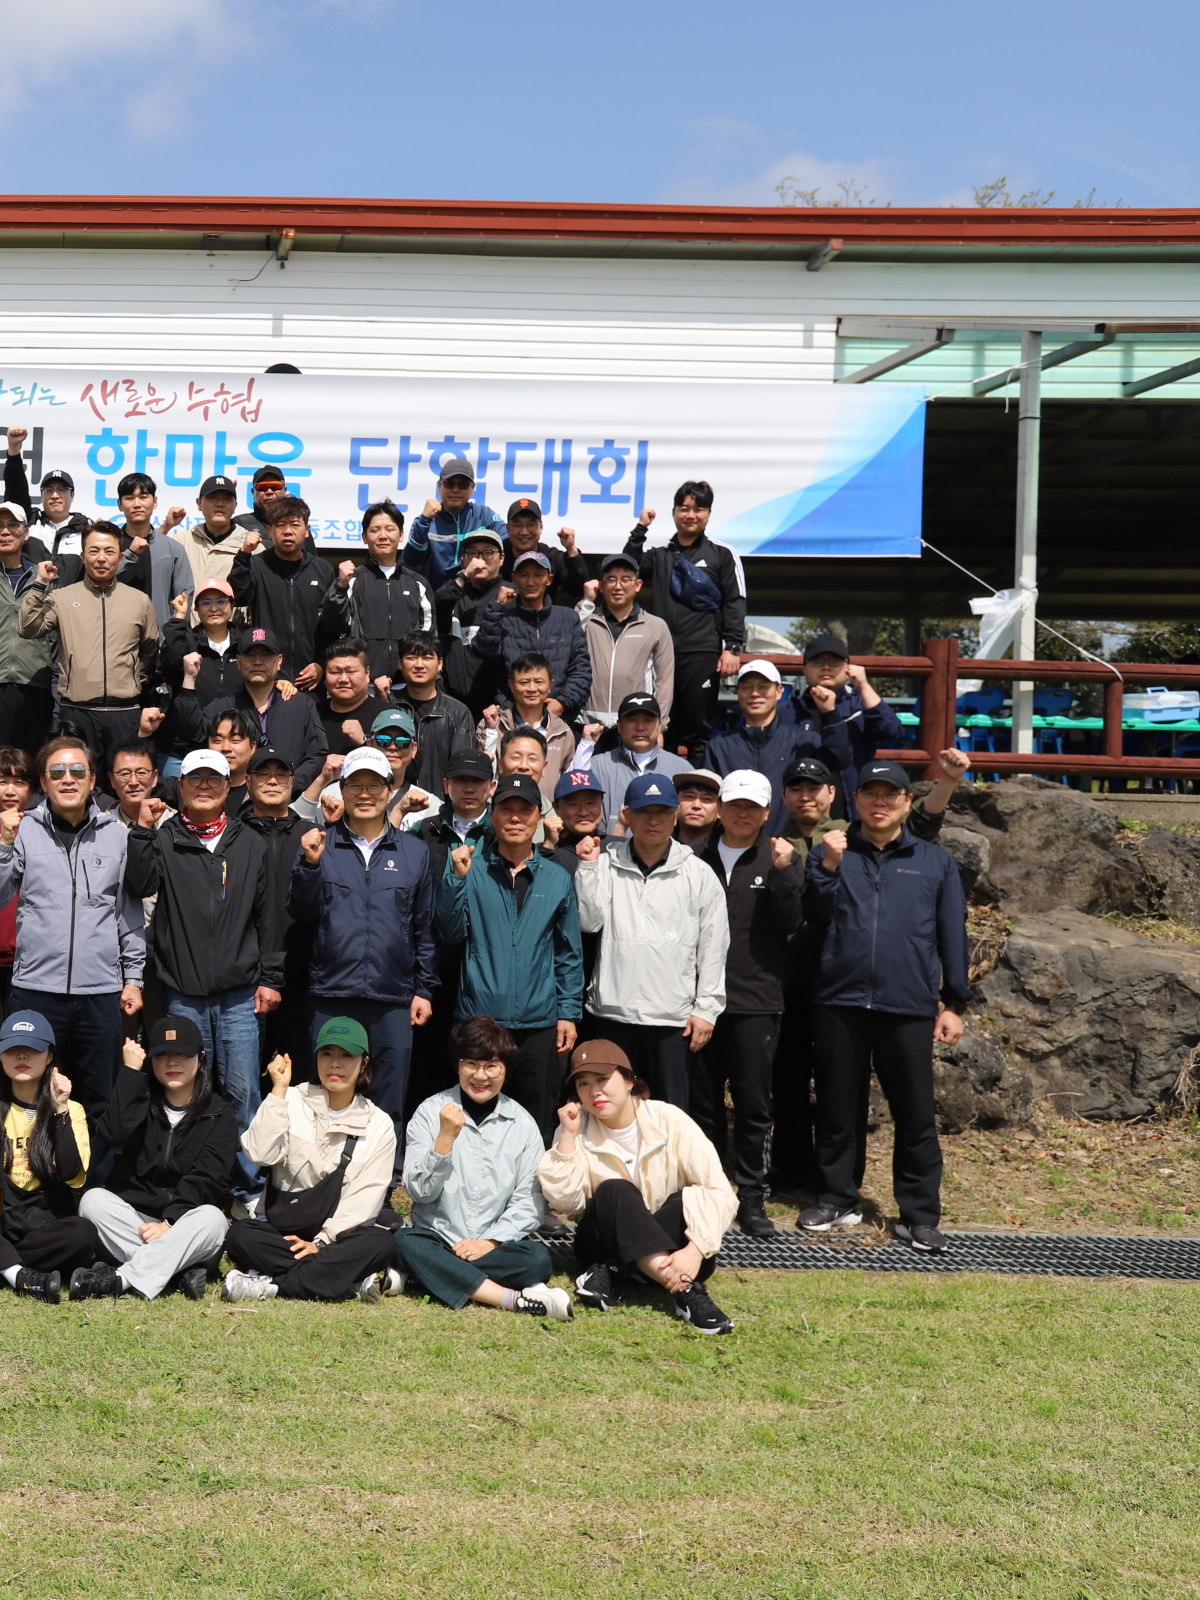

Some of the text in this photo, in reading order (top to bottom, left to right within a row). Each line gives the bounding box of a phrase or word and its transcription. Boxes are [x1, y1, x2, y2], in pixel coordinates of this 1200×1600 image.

[80, 378, 178, 422] 새로운
[187, 377, 262, 423] 수협
[85, 427, 312, 509] 한마음
[349, 435, 649, 518] 단합대회
[570, 772, 591, 786] NY
